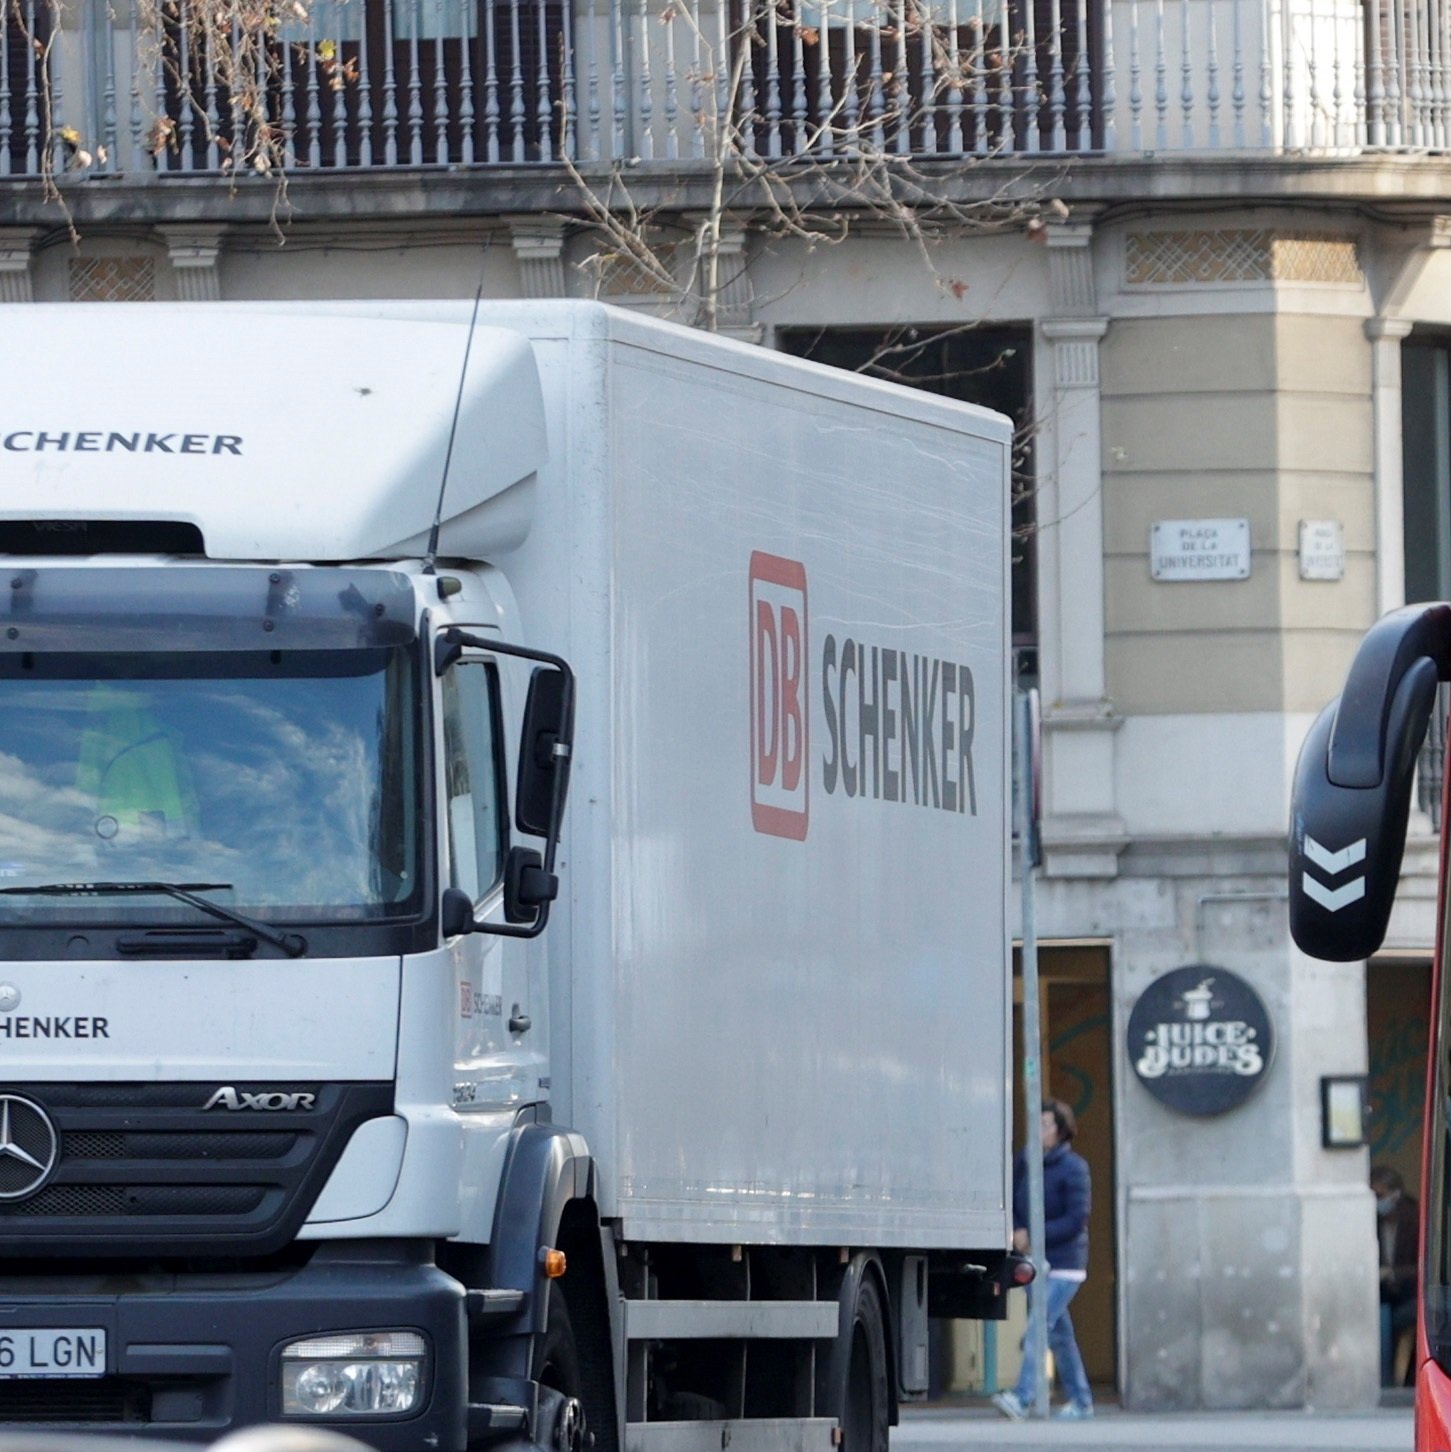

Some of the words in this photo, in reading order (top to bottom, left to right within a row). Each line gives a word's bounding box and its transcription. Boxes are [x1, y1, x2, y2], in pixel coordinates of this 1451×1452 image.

[0, 431, 243, 455] CHENKER
[1159, 554, 1240, 569] UNIVERSITAT
[757, 600, 802, 791] DB
[823, 634, 977, 816] SCHENKER
[1157, 1021, 1247, 1049] JUICE
[1136, 1043, 1262, 1078] DUDES
[203, 1086, 316, 1111] AXOR
[30, 1336, 95, 1367] LGN
